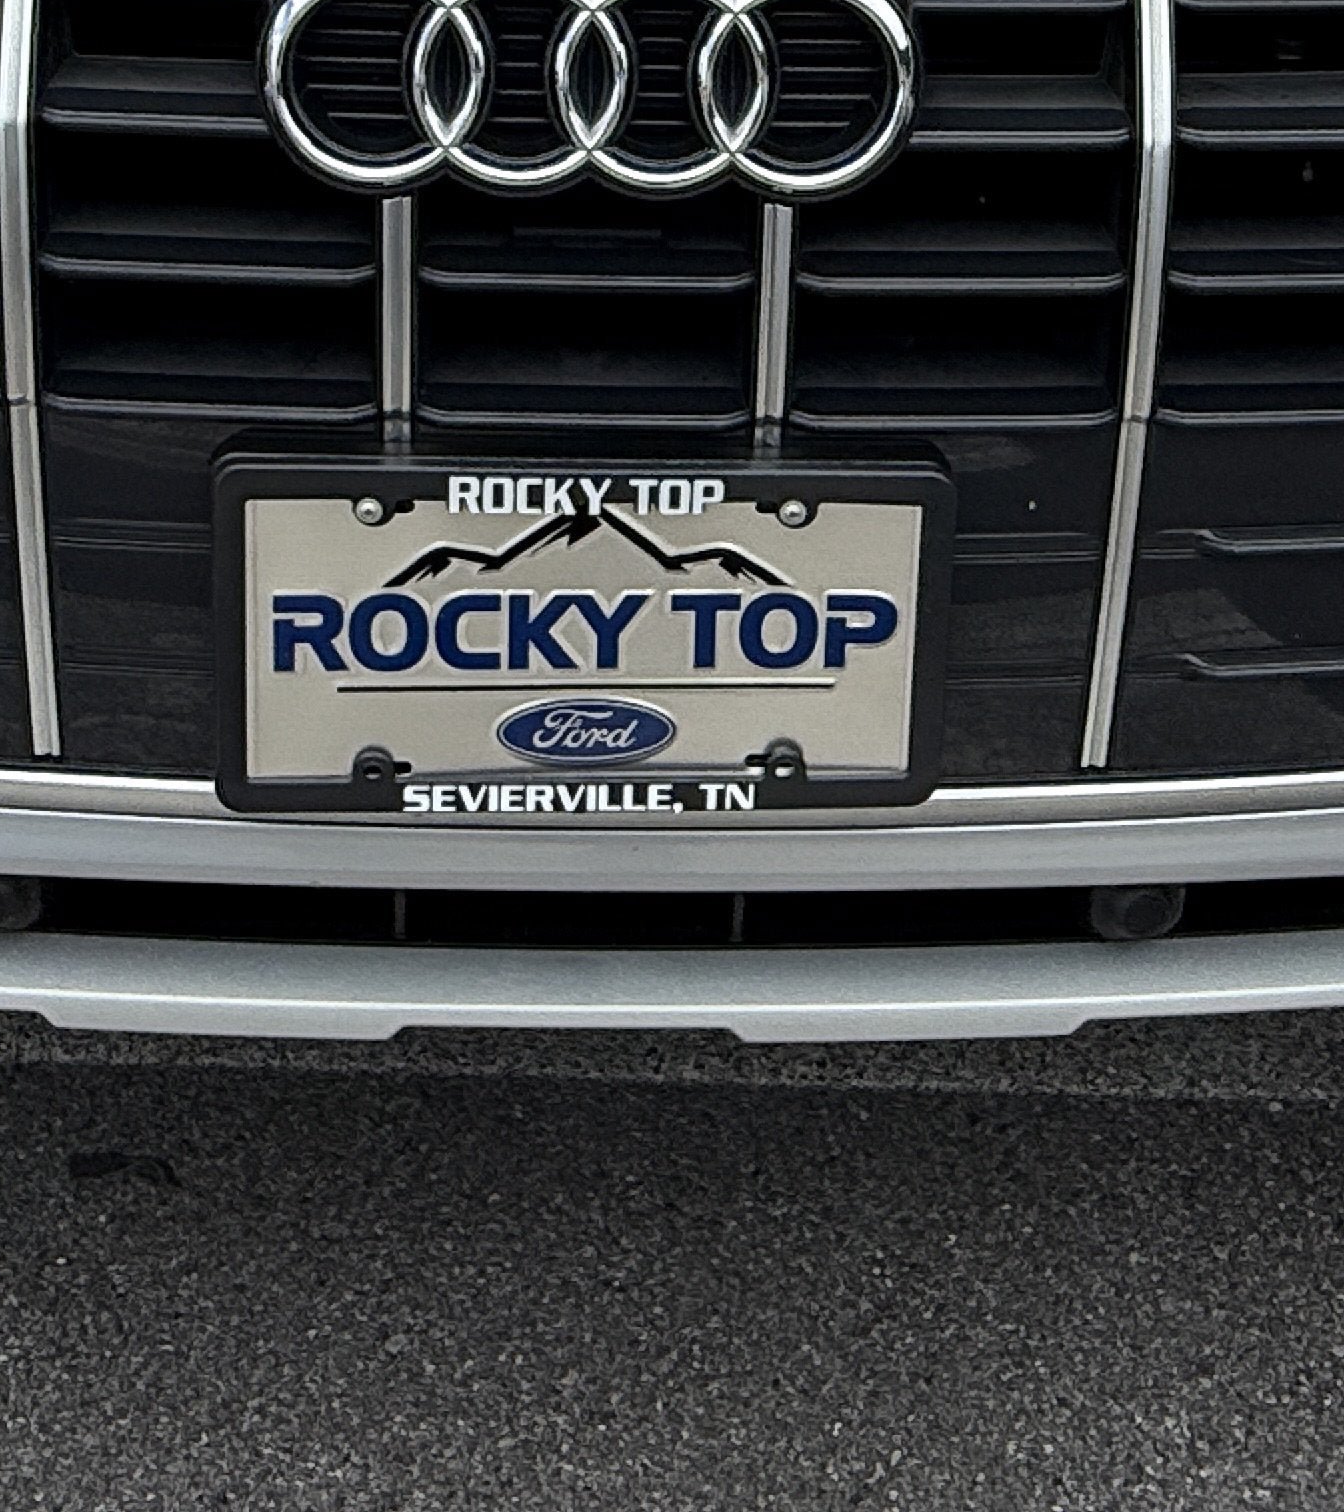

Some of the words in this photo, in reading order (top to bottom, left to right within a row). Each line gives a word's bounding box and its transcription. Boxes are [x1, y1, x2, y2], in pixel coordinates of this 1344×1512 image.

[448, 476, 612, 517] ROCKY
[628, 477, 726, 516] TOP
[271, 589, 656, 673] ROCKY
[669, 589, 898, 672] TOP
[530, 707, 638, 751] Ford
[402, 783, 685, 815] SEVIERVILLE,
[698, 783, 757, 813] TN
